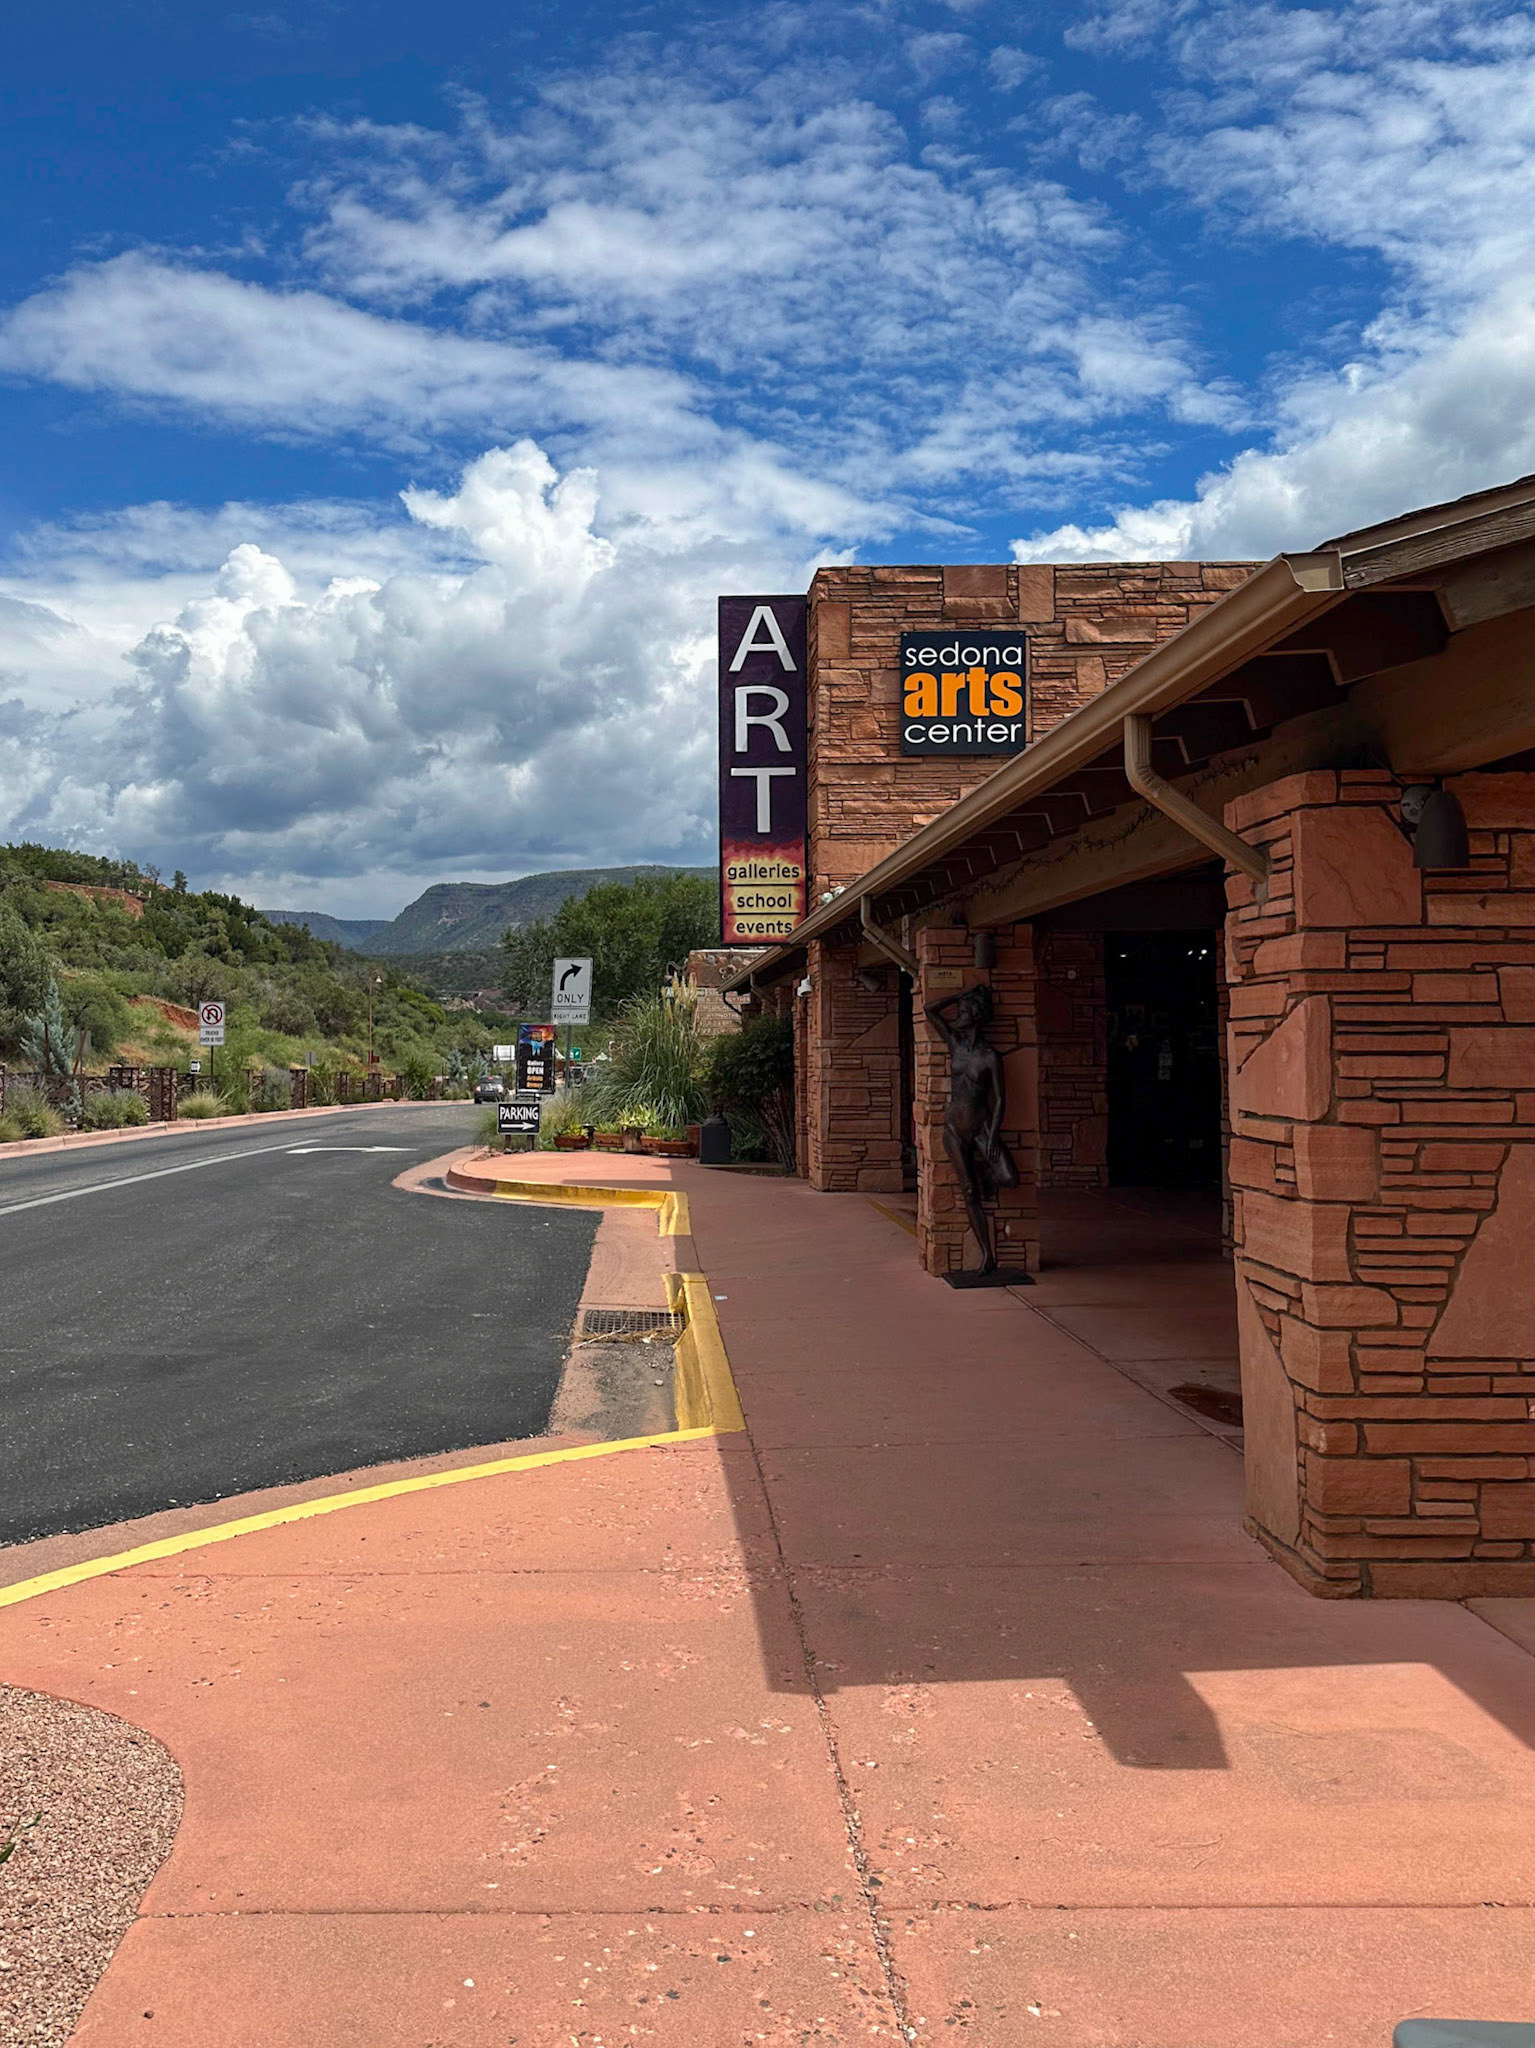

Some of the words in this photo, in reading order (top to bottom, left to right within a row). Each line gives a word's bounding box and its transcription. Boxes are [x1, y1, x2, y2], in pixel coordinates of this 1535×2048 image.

[905, 641, 1023, 666] sedona
[903, 667, 1024, 717] arts
[728, 605, 798, 834] ART
[904, 718, 1023, 744] center
[727, 862, 800, 880] galleries
[736, 893, 792, 909] school
[735, 920, 793, 934] events
[557, 993, 584, 1003] ONLY
[526, 1066, 544, 1075] OPEN
[500, 1106, 539, 1121] PARKING
